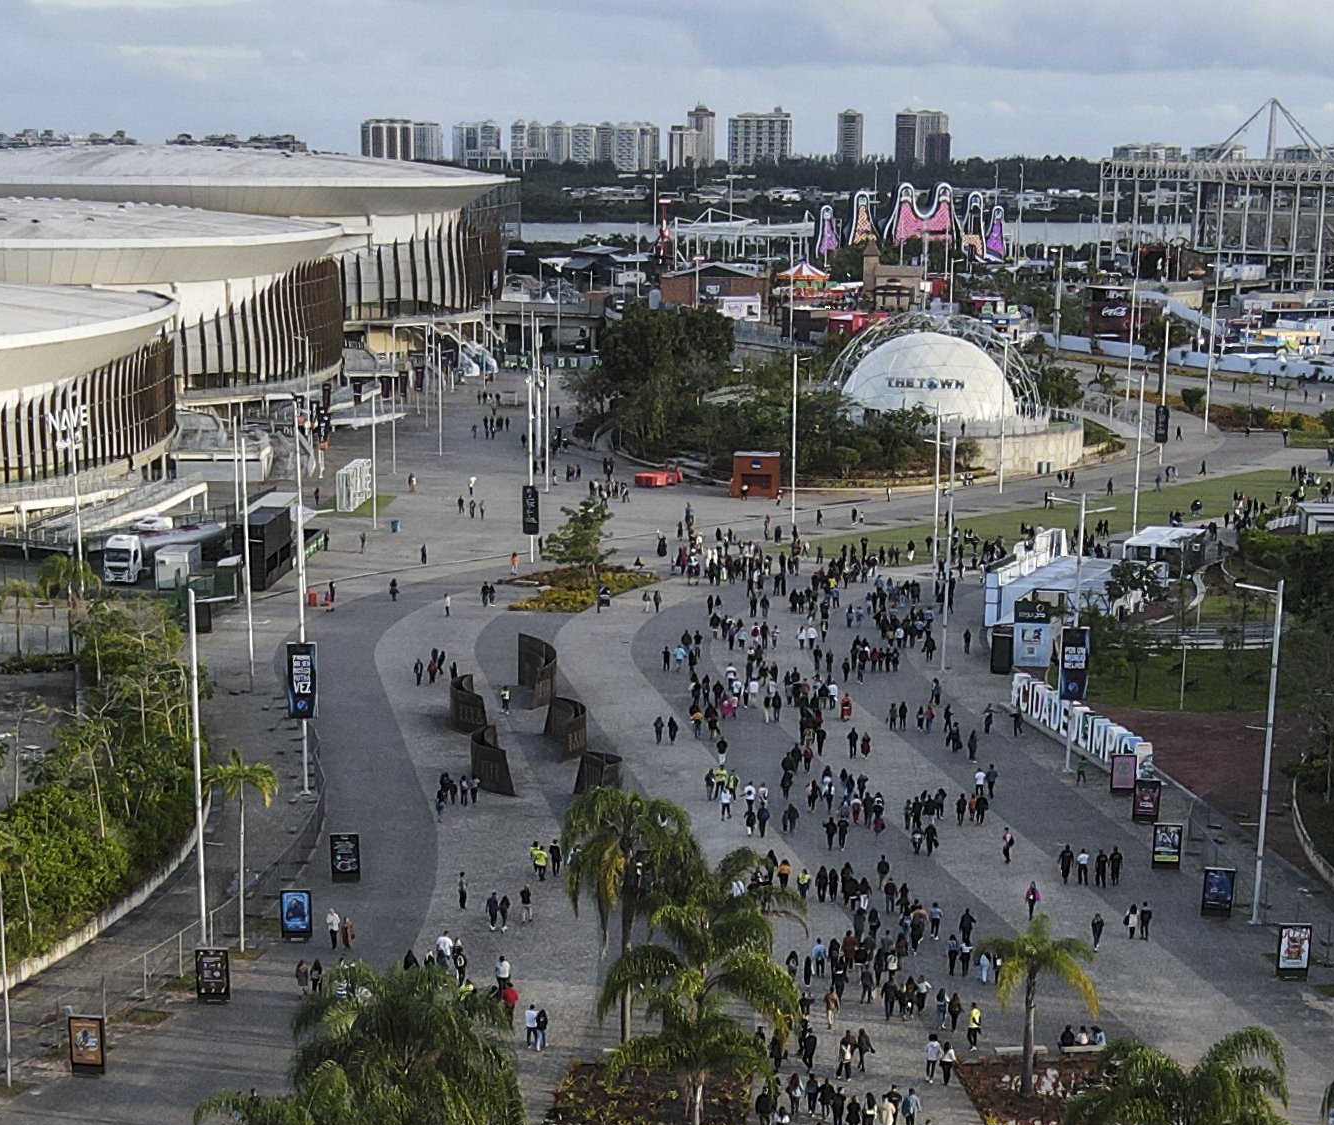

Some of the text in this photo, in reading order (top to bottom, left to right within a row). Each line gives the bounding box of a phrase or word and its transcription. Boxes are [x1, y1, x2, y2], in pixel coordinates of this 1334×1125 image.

[887, 377, 965, 391] THE TOWN
[48, 404, 88, 434] NAVE
[293, 682, 311, 693] VEZ
